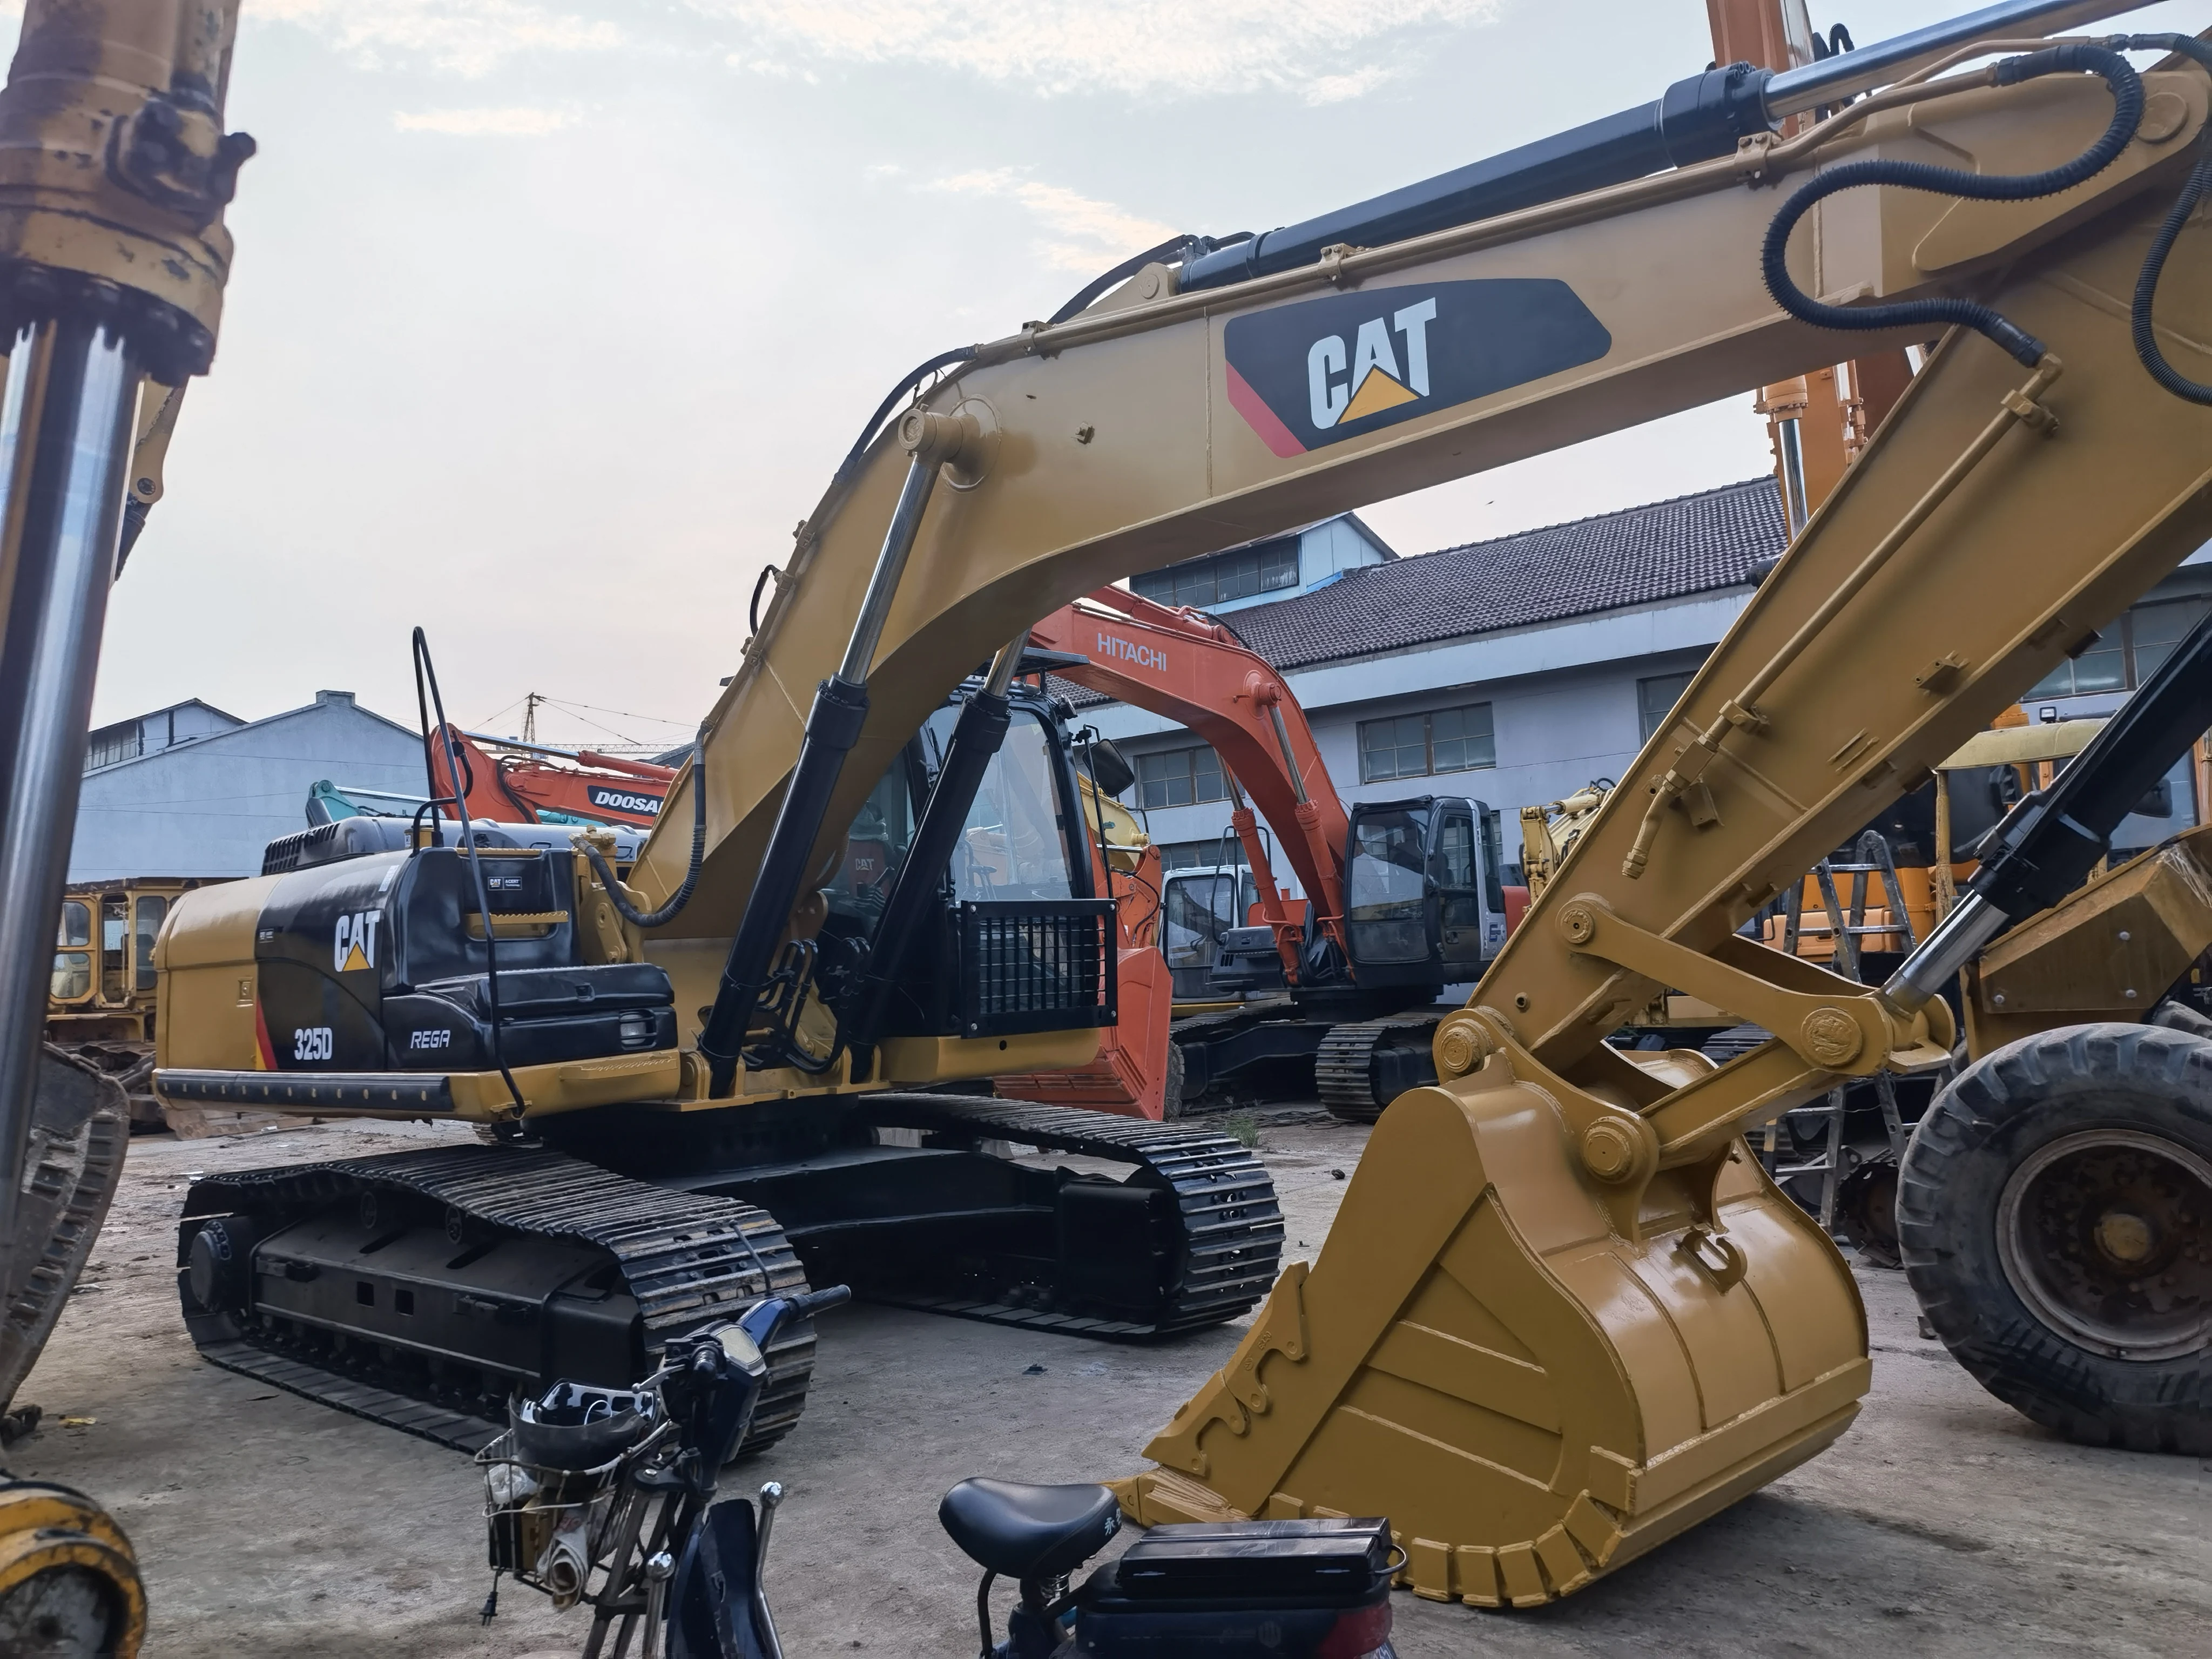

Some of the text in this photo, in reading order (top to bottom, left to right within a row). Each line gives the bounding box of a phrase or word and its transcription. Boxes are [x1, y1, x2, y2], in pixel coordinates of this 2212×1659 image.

[1307, 296, 1437, 430] CAT
[1097, 632, 1166, 672] HITACHI
[855, 858, 875, 871] CAT
[334, 909, 381, 972] CAT
[294, 1028, 333, 1060] 325D
[410, 1030, 450, 1049] REGA
